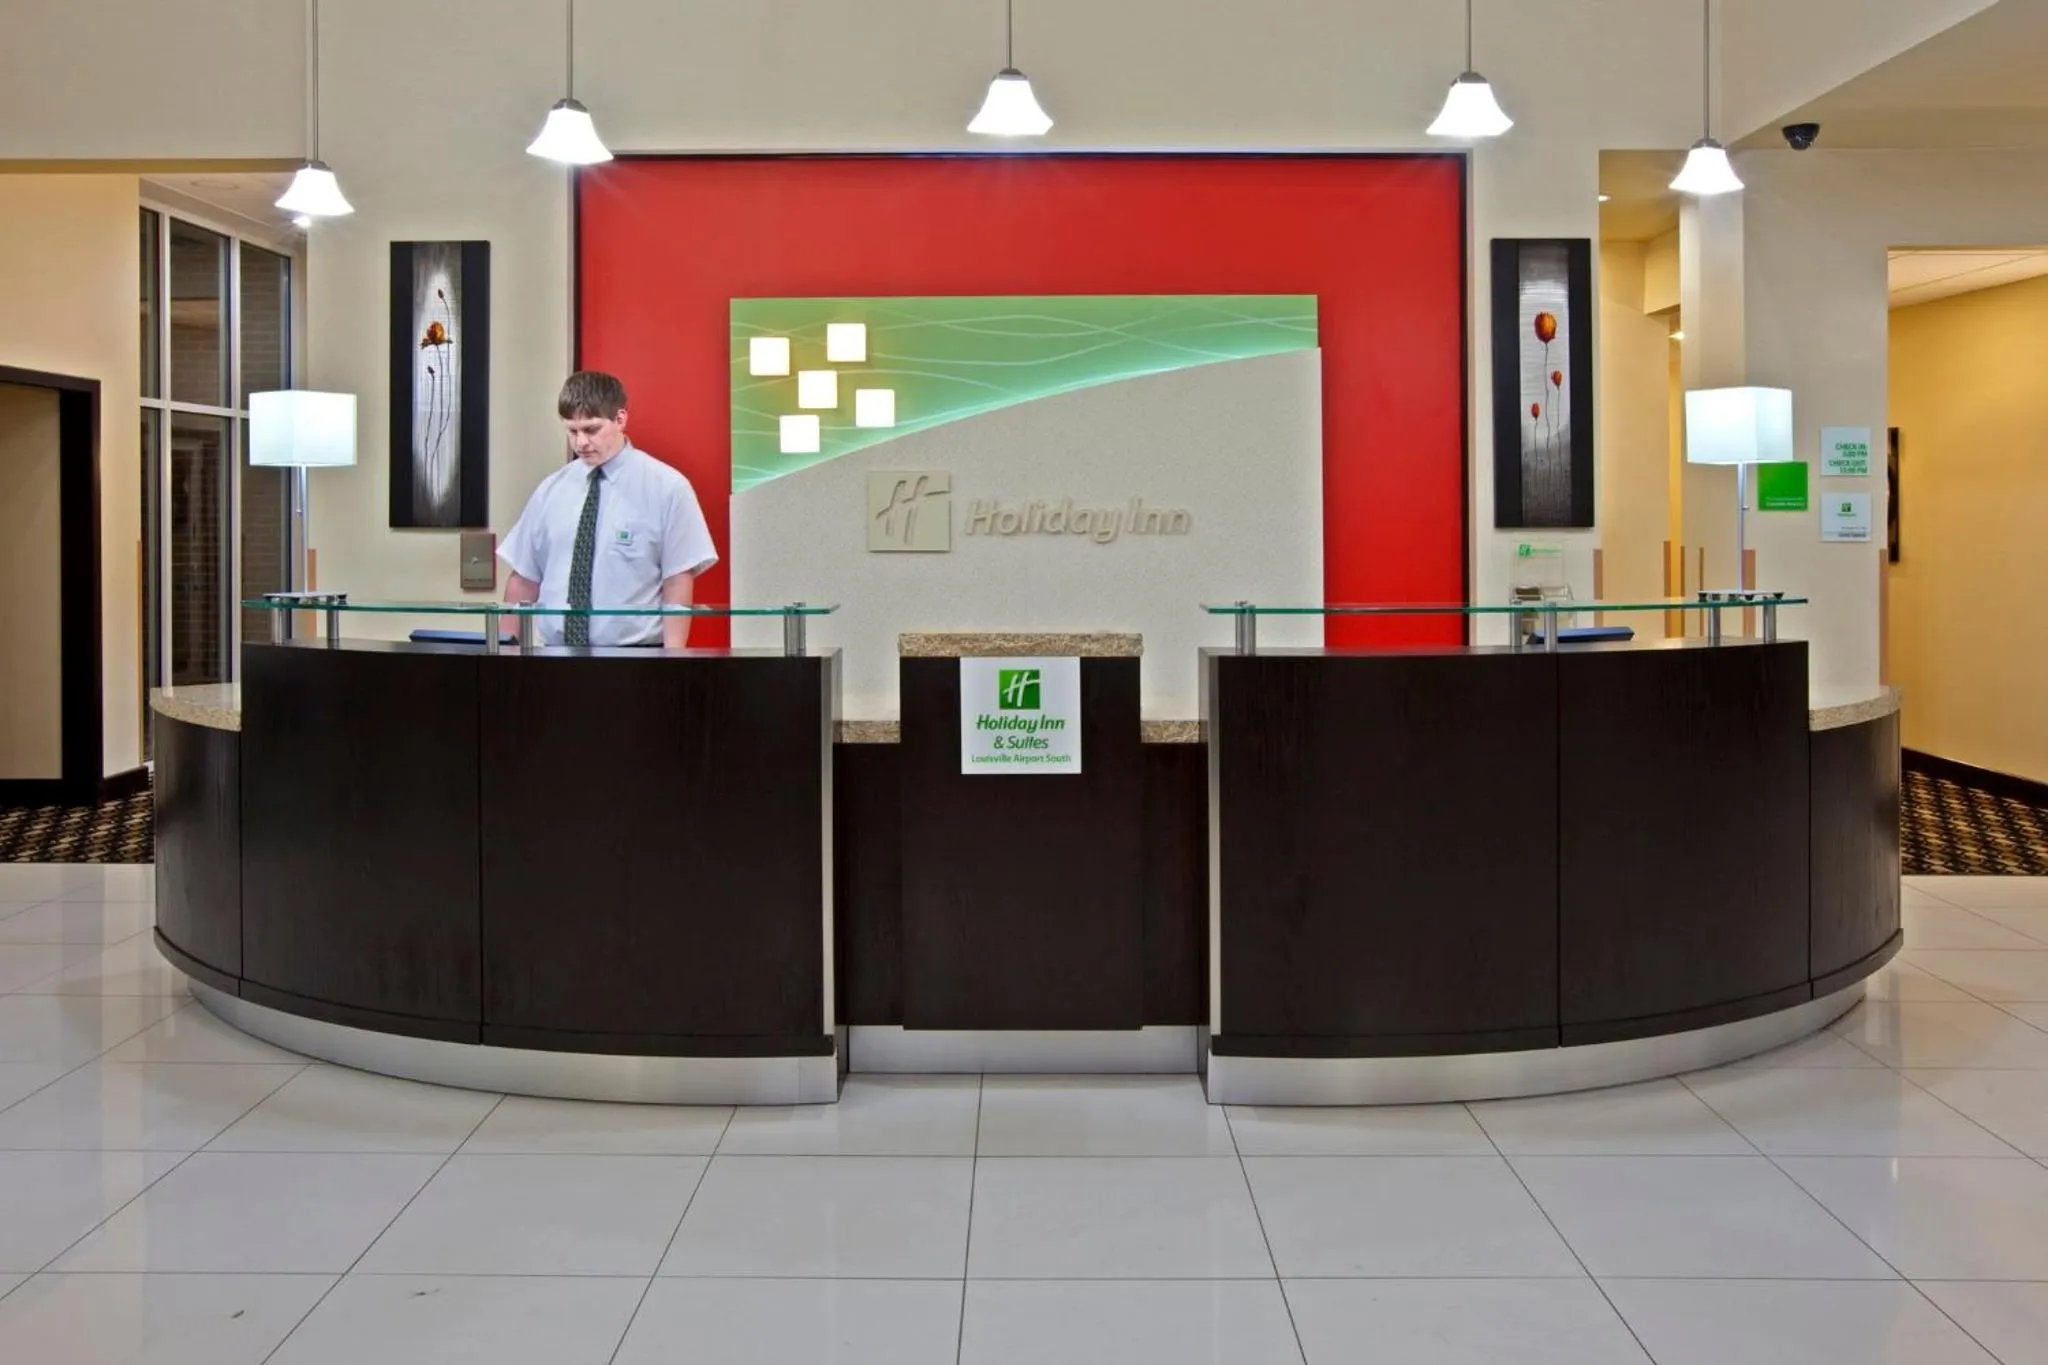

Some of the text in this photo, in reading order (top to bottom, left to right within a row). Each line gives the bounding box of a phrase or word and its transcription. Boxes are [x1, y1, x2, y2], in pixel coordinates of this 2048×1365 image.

[965, 500, 1120, 544] Holiday
[1127, 498, 1194, 536] Inn
[976, 714, 1066, 733] Holiday Inn
[993, 735, 1050, 749] & Suites
[971, 753, 1072, 765] Louisville Airport South
